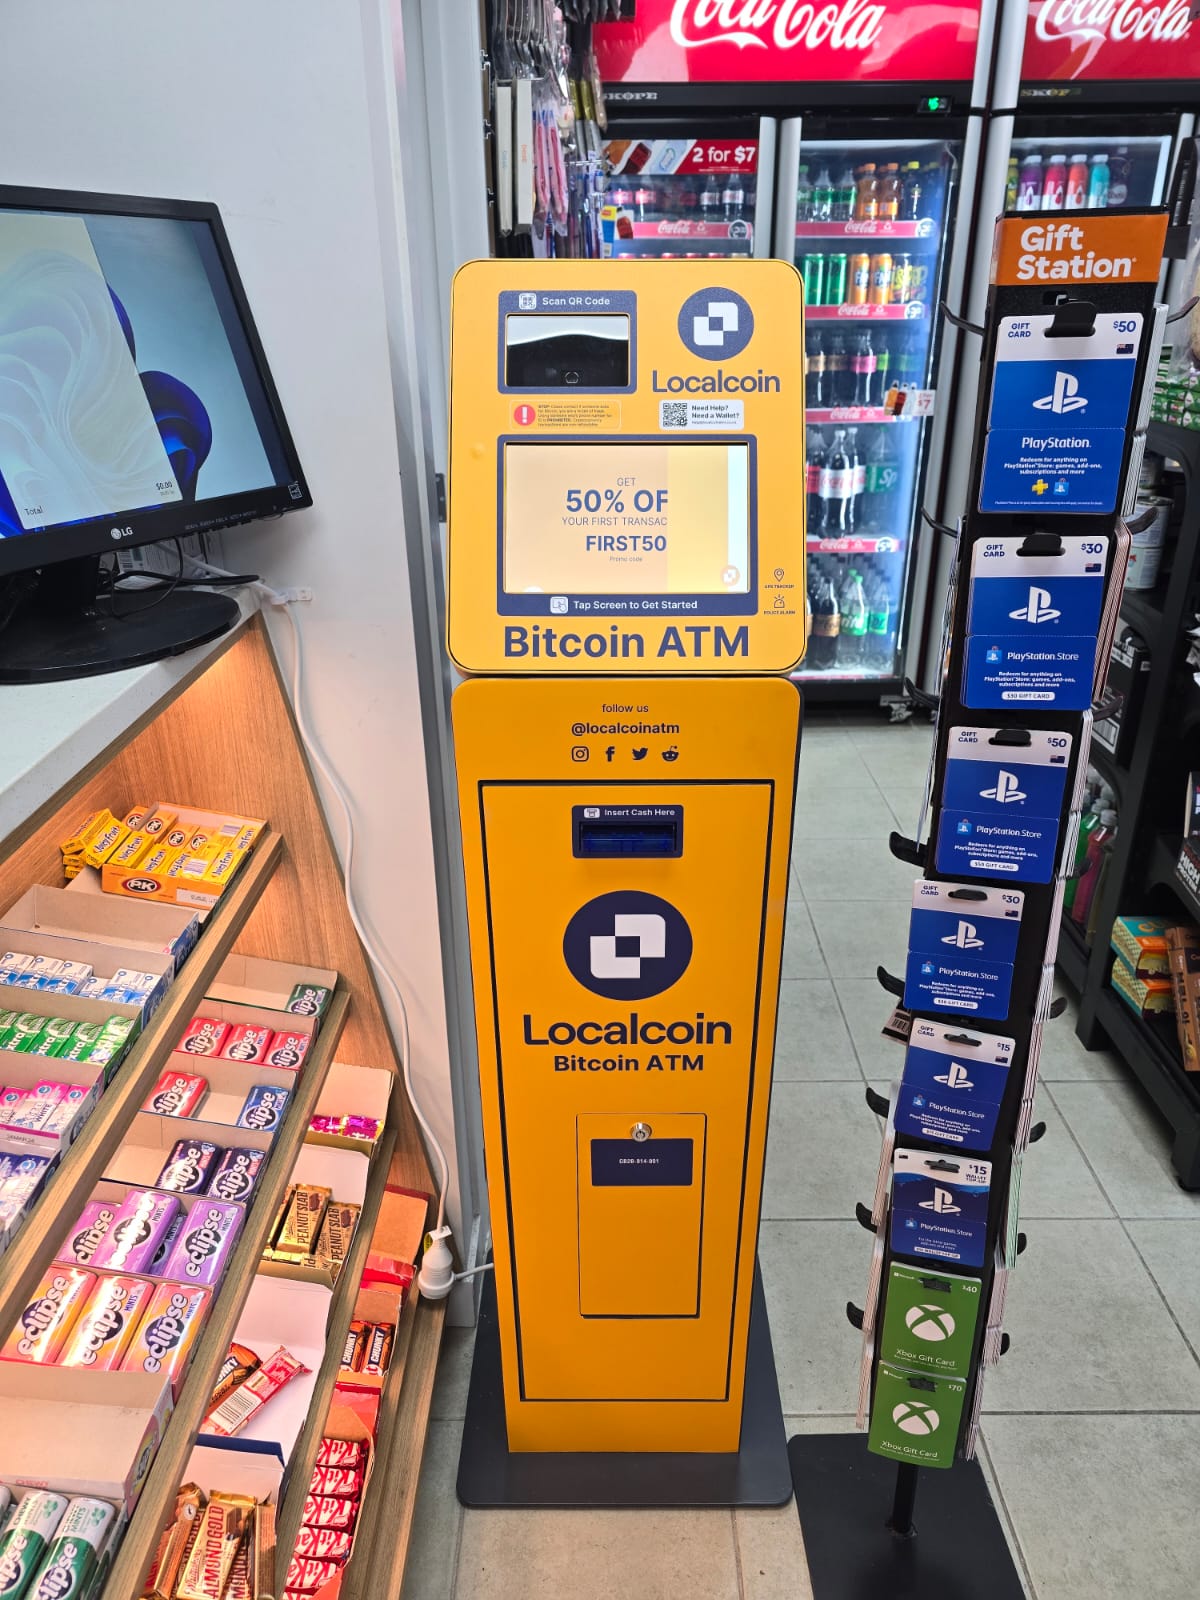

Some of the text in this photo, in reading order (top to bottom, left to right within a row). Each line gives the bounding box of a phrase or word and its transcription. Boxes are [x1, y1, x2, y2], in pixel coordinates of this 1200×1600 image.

[670, 0, 887, 49] CocaCola
[692, 145, 756, 164] 2 for $7
[1020, 224, 1084, 252] Gift
[542, 295, 611, 307] Scan QR Code
[1007, 330, 1032, 339] CARD
[1011, 320, 1137, 334] GIFT $50
[652, 369, 781, 393] Localcoin
[691, 404, 729, 414] Need Help?
[691, 412, 709, 420] Need
[715, 412, 740, 420] Wallet?
[1053, 457, 1079, 465] anything
[616, 476, 637, 487] GET
[566, 488, 668, 513] 50% OF
[24, 505, 44, 517] Total
[561, 516, 668, 527] YOUR FIRST TRANSAC
[121, 526, 133, 537] LG
[585, 535, 668, 552] FIRST50
[1080, 543, 1104, 554] $30
[629, 555, 643, 563] code
[573, 600, 698, 611] Tap Screen to Get Started
[503, 625, 750, 658] Bitcoin ATM
[1057, 653, 1080, 662] Store
[602, 703, 649, 713] follow us
[571, 722, 680, 737] @localcoinatm
[958, 736, 979, 744] CARD
[1047, 737, 1067, 748] $50
[604, 808, 676, 816] Insert Cash Here
[1179, 851, 1200, 885] HIGH
[129, 879, 155, 892] P.K
[1002, 894, 1020, 904] $30
[291, 988, 317, 1016] lipse
[523, 1012, 732, 1046] Localcoin
[8, 1032, 26, 1051] xtra
[38, 1036, 56, 1056] xtra
[69, 1041, 87, 1061] xtra
[996, 1042, 1011, 1052] $15
[554, 1054, 704, 1072] Bitcoin ATM
[220, 1154, 251, 1201] clipse
[968, 1163, 988, 1175] $15
[296, 1191, 309, 1245] PEANUT SLAB
[75, 1209, 114, 1265] clipse
[185, 1208, 223, 1278] eclipse
[328, 1207, 344, 1261] PEANUT SLAB
[962, 1285, 978, 1293] $40
[17, 1275, 70, 1356] eclipse
[82, 1285, 128, 1365] eclipse
[143, 1293, 188, 1373] eclipse
[342, 1332, 357, 1363] CHUNKY
[370, 1330, 385, 1363] CHUNKY
[896, 1348, 918, 1360] Xbox
[918, 1354, 934, 1364] Gift
[934, 1357, 955, 1367] Card
[881, 1440, 903, 1452] Xbox
[903, 1446, 918, 1456] Gift
[918, 1449, 938, 1459] Card
[309, 1466, 350, 1494] KitKa
[303, 1494, 346, 1525] KitKa
[202, 1504, 225, 1600] ALMOND GOLD
